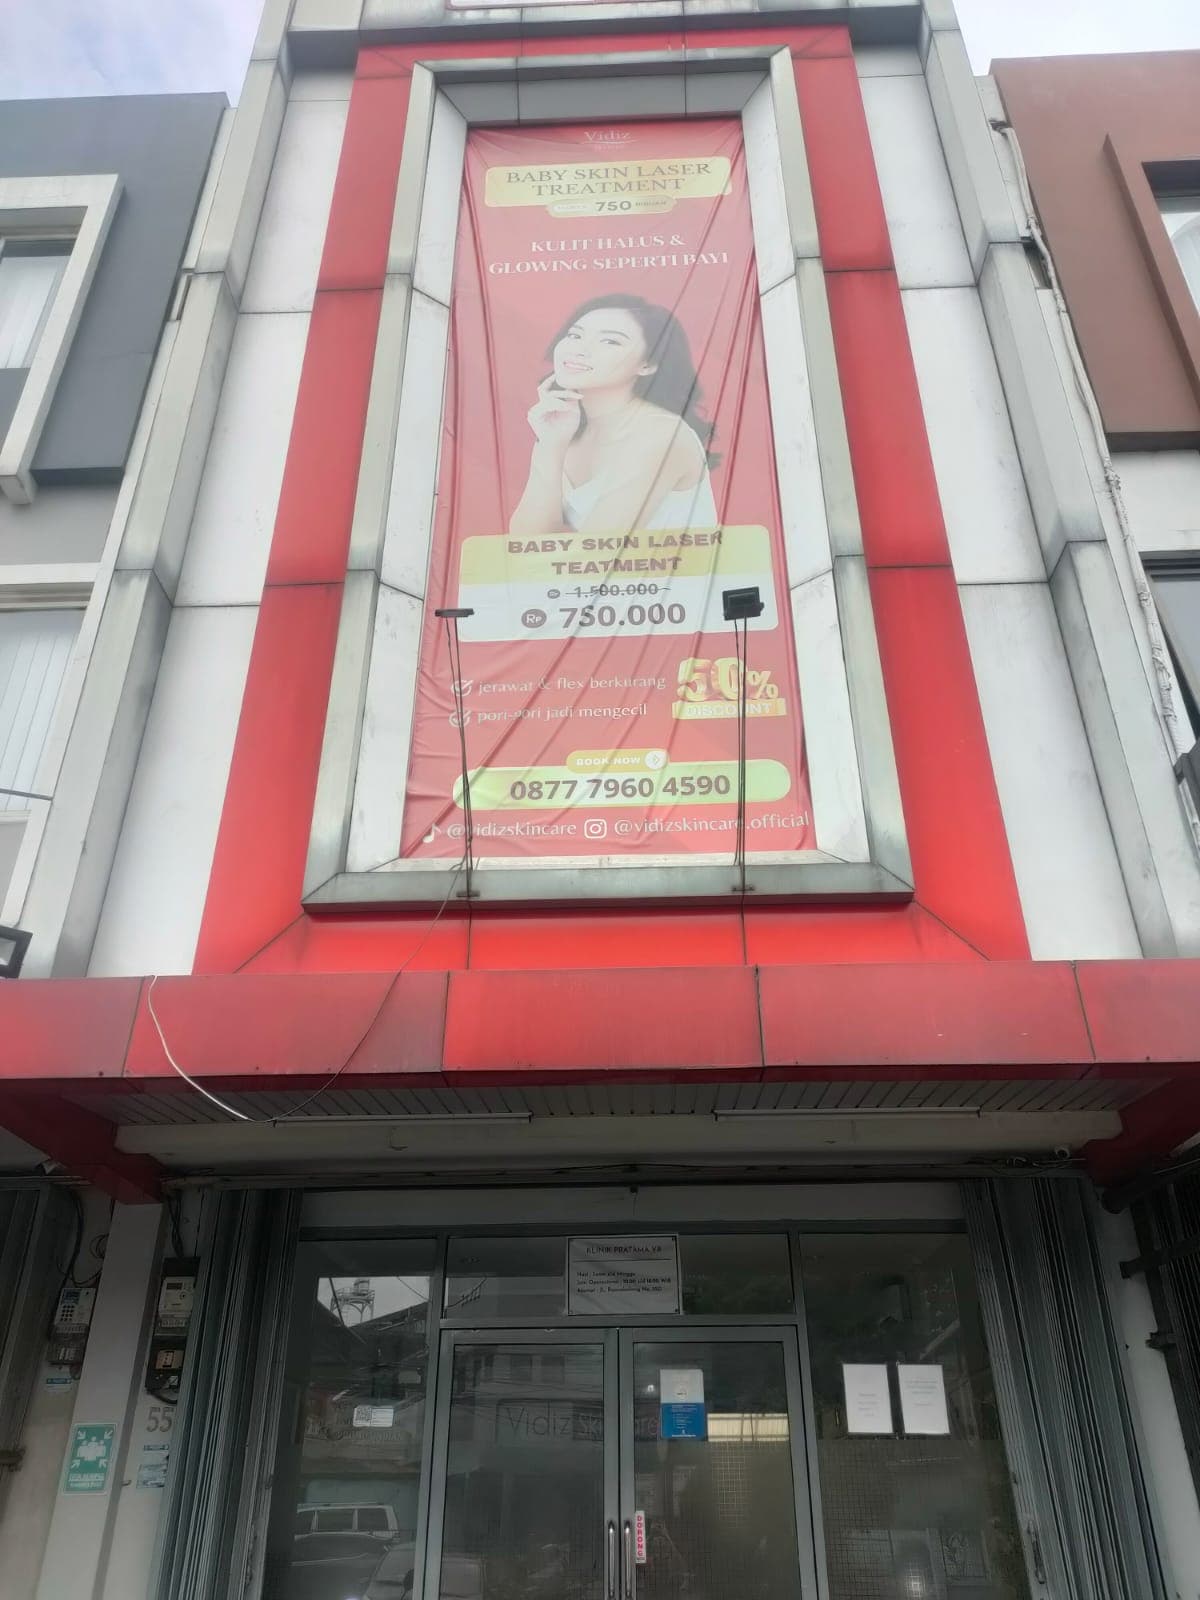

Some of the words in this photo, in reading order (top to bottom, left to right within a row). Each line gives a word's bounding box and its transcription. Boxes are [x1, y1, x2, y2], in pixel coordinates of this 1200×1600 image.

[584, 130, 632, 142] Vidiz
[506, 168, 568, 184] BABY
[574, 166, 629, 181] SKIN
[635, 162, 712, 177] LASER
[532, 178, 686, 197] TREATMENT
[595, 200, 632, 213] 750
[531, 238, 593, 253] KULIT
[597, 235, 665, 250] HALUS
[670, 234, 686, 246] &
[488, 258, 588, 275] GLOWING
[592, 254, 678, 271] SEPERTI
[682, 252, 728, 267] BAYI
[508, 538, 574, 554] BABY
[581, 536, 640, 551] SKIN
[648, 530, 723, 548] LASER
[551, 556, 683, 575] TEATMENT
[573, 583, 660, 598] 1.500.000
[526, 613, 543, 625] Rp
[558, 603, 687, 628] 750.000
[478, 681, 533, 696] jerawat
[540, 679, 552, 690] &
[557, 677, 584, 689] flex
[589, 675, 666, 690] berkurang
[677, 657, 779, 702] 50%
[543, 706, 574, 721] jadi
[579, 703, 647, 720] mengecil
[687, 703, 772, 716] DISCONT
[576, 757, 611, 767] BOOK
[613, 755, 641, 765] NOW
[510, 779, 578, 801] 0877
[586, 777, 654, 799] 7960
[662, 774, 731, 796] 4590
[613, 1245, 650, 1254] PRATAMA
[146, 1406, 174, 1433] 55
